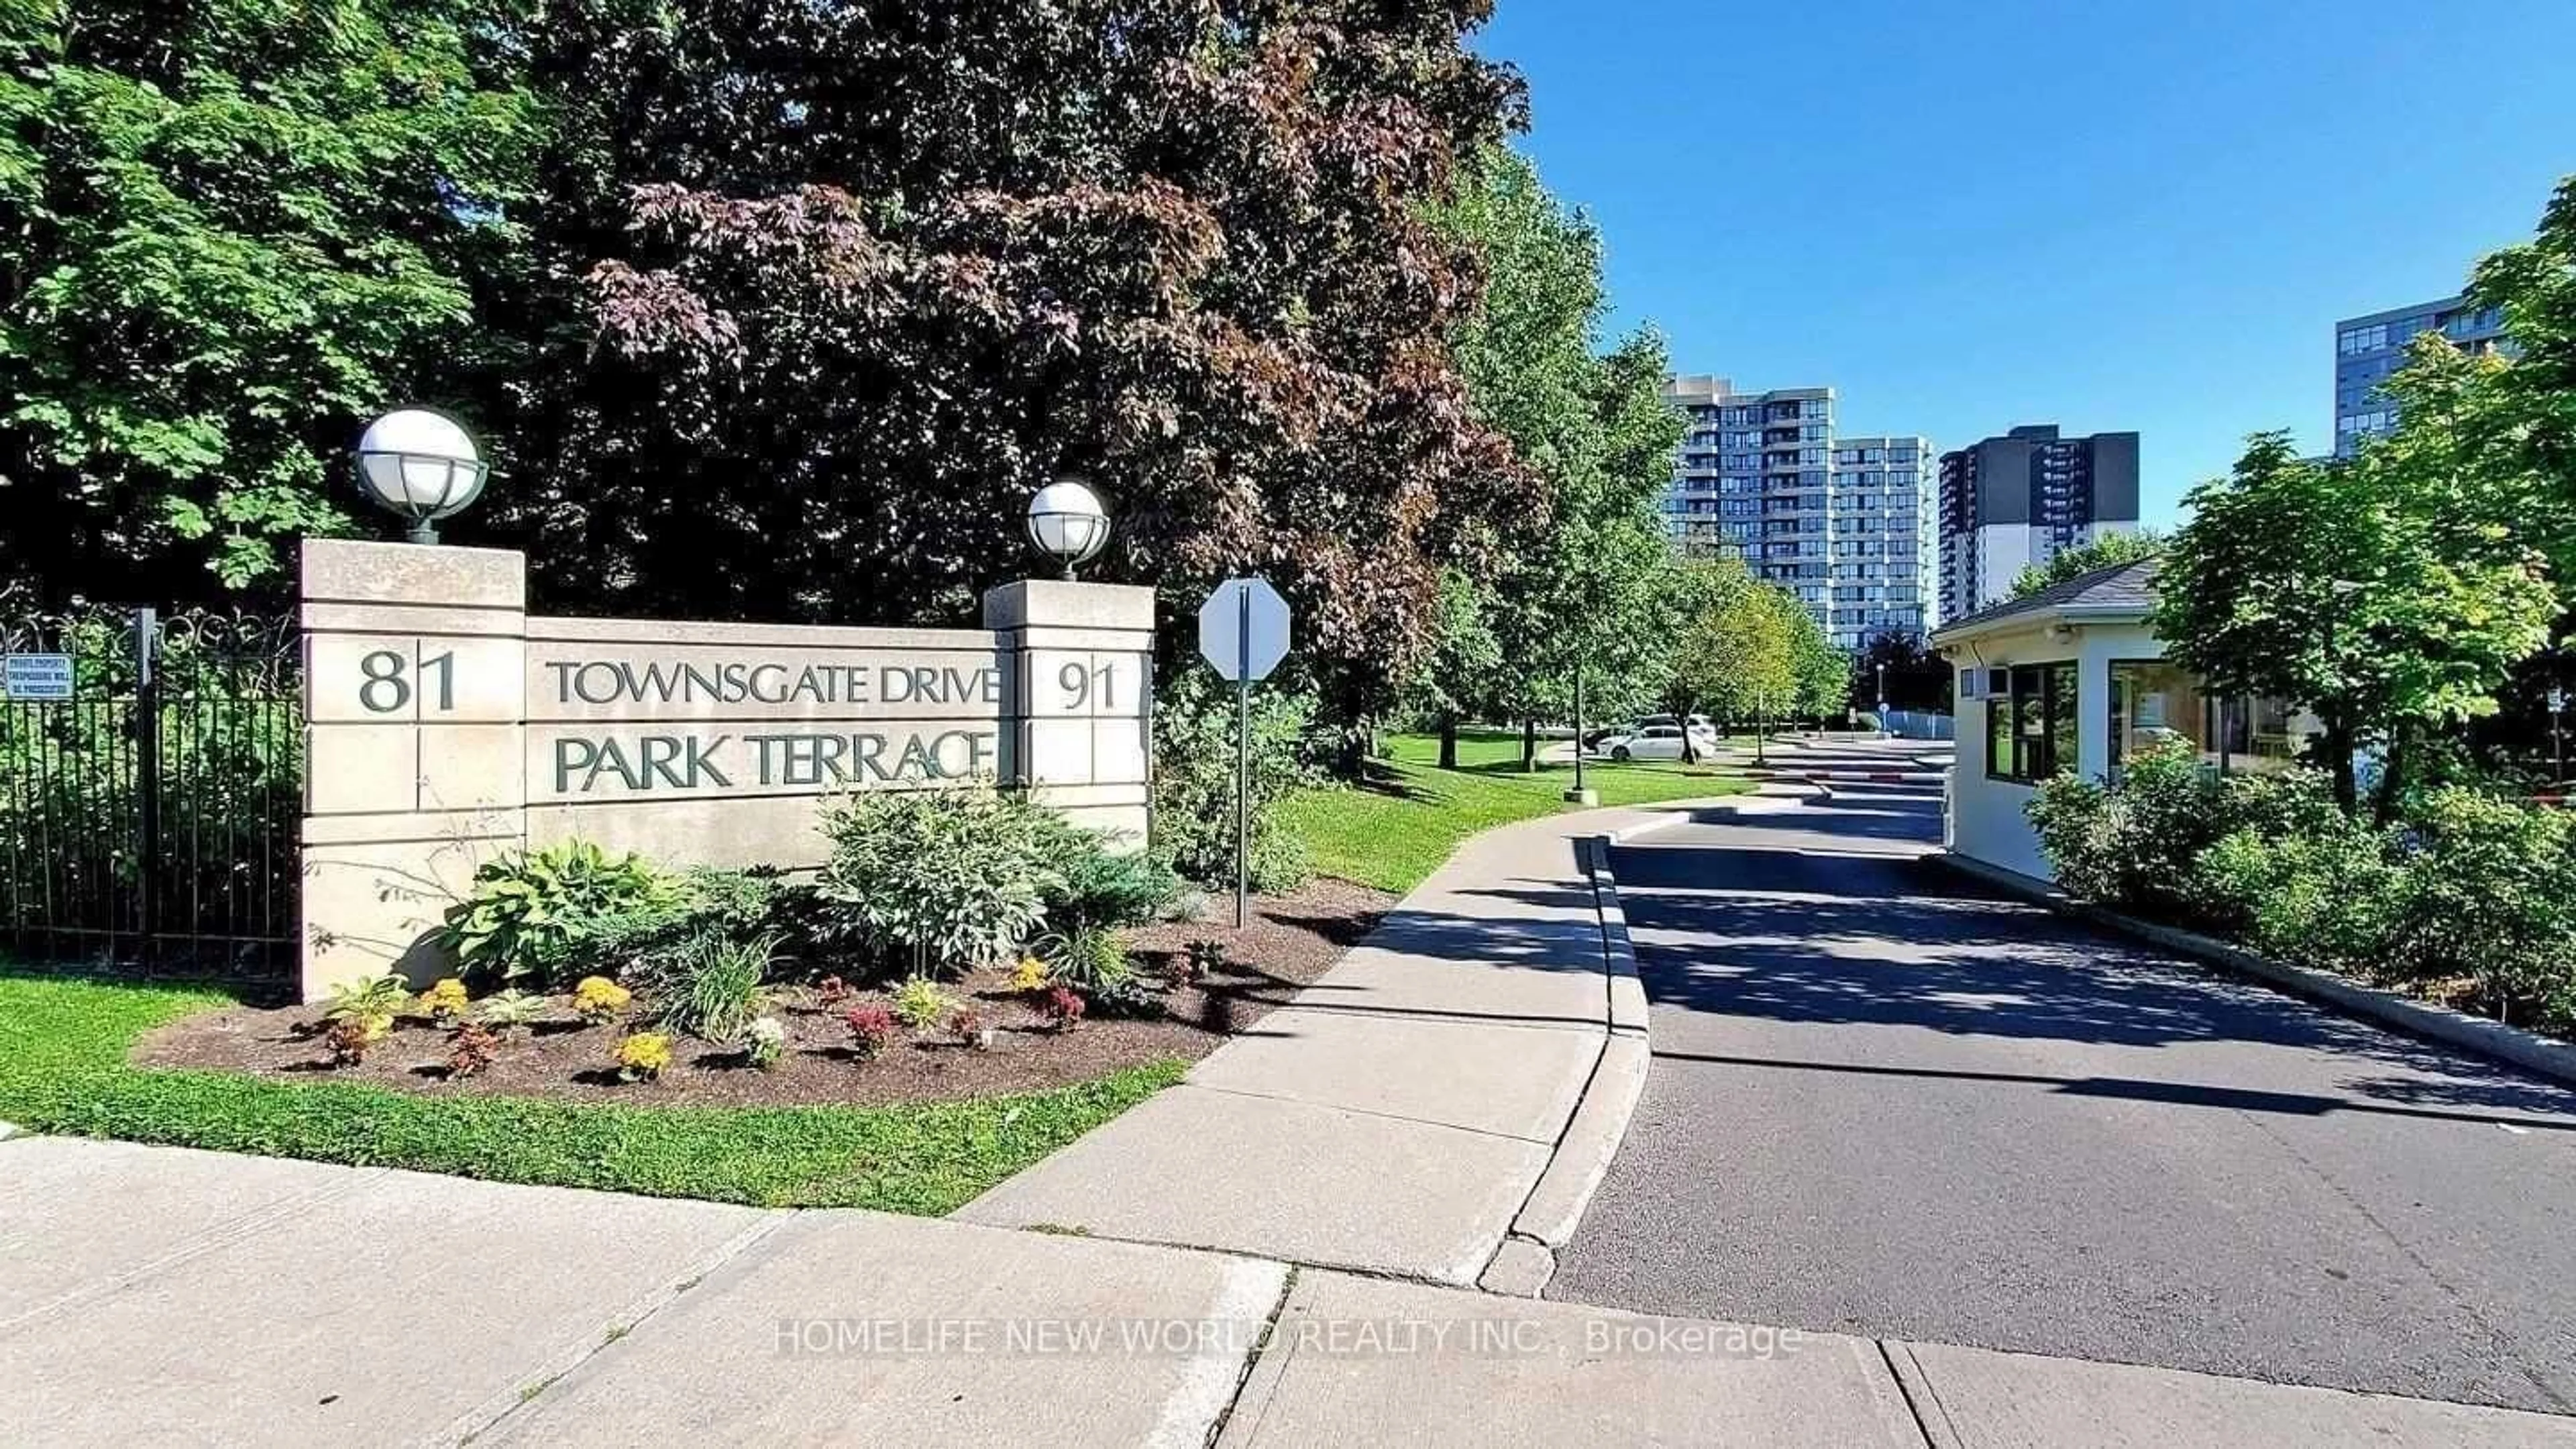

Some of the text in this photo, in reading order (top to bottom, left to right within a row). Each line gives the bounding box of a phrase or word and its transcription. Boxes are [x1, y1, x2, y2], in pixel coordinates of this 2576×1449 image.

[359, 651, 453, 712] 81
[545, 661, 1002, 704] TOWNSGATE DRIVE
[1059, 662, 1116, 710] 91
[555, 729, 996, 792] PARK TERRACE
